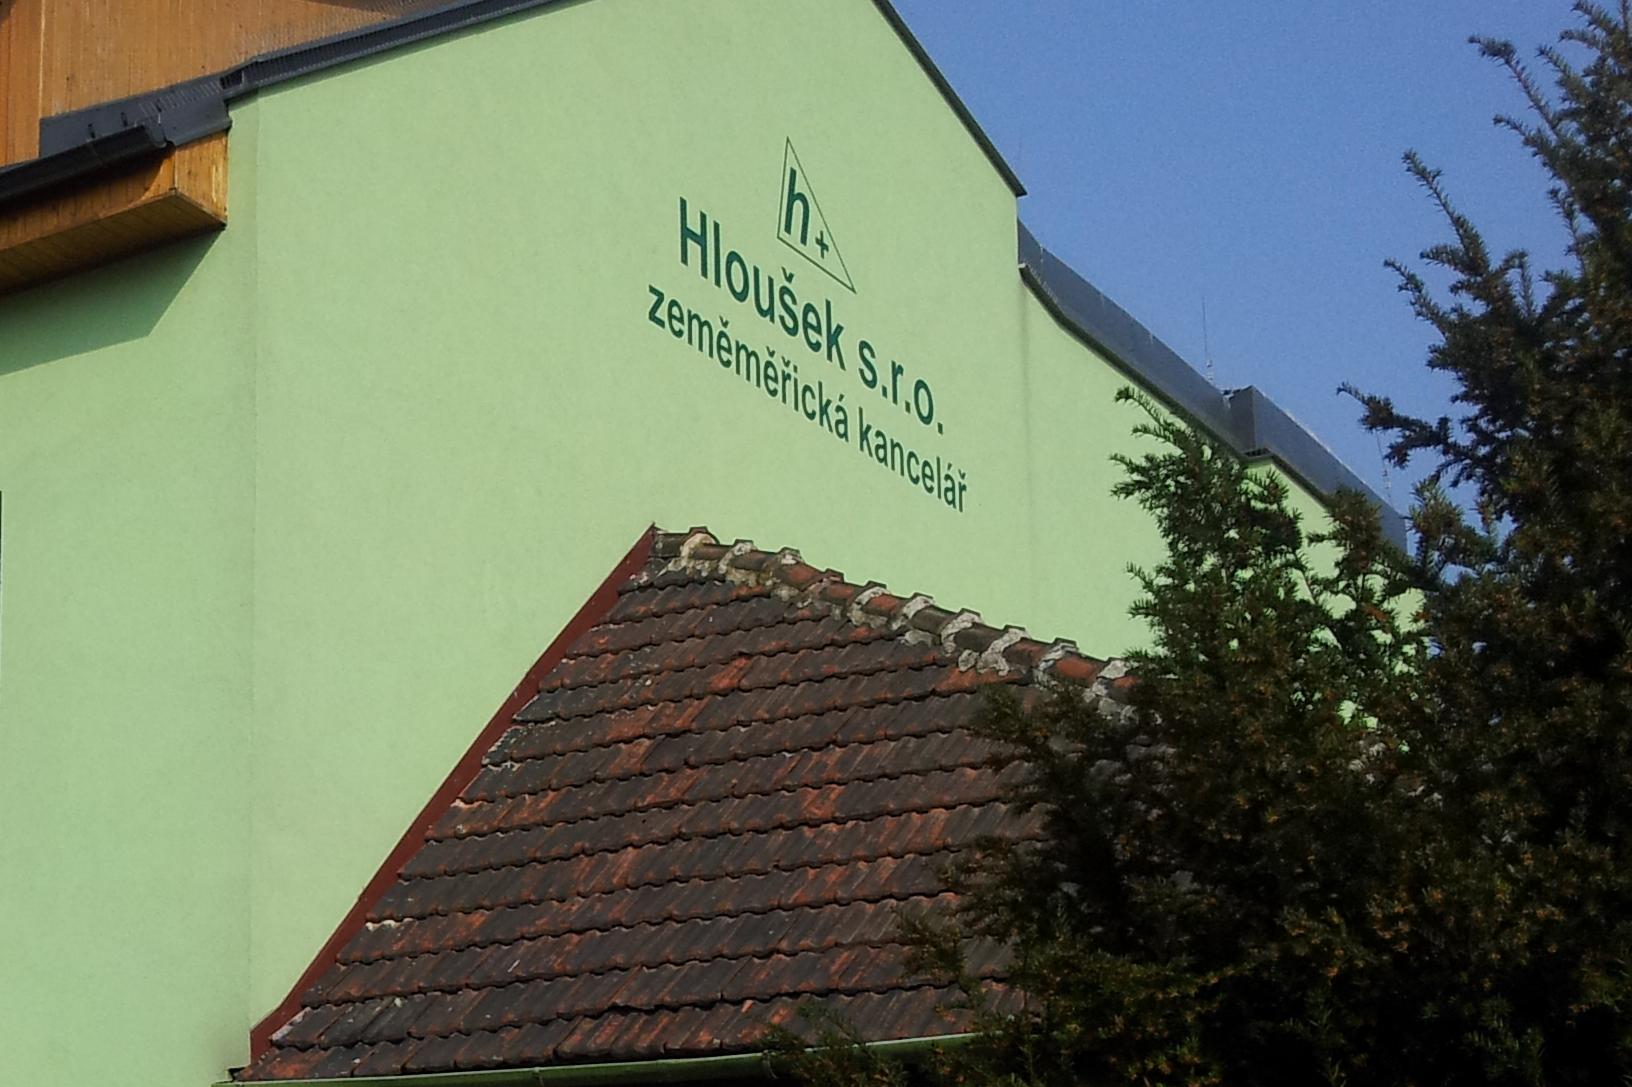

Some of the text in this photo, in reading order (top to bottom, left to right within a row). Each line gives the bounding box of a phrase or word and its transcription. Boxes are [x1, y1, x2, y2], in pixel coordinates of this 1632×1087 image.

[648, 284, 967, 512] zeměměřická kancelář
[679, 196, 944, 435] Hloušek s.r.o.
